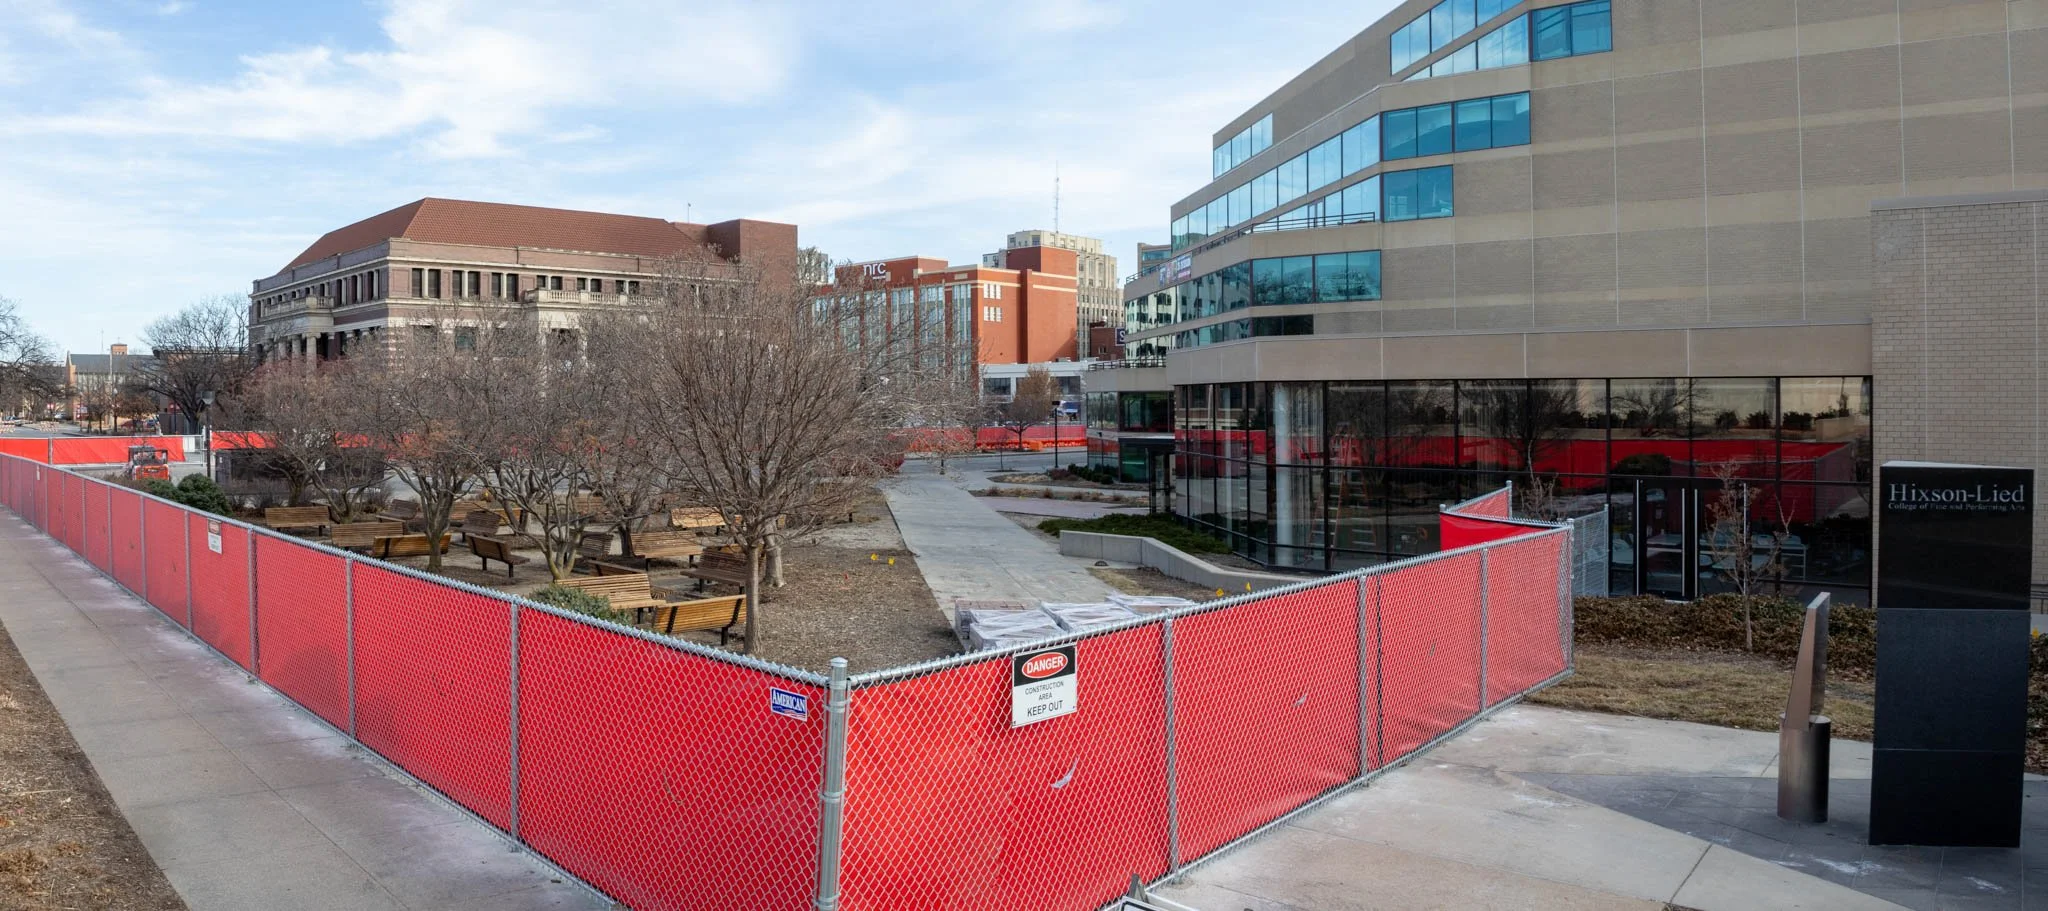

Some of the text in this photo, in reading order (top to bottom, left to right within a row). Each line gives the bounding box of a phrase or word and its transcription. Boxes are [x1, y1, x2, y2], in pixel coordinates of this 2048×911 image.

[863, 262, 886, 276] nrc
[1889, 483, 2024, 502] Hixson-Lied
[1888, 503, 1917, 511] College
[1026, 656, 1064, 674] DANGER
[1025, 681, 1064, 695] CONSTRUCTION
[772, 689, 806, 713] AMERICAN
[1038, 692, 1053, 701] AREA
[1027, 700, 1063, 717] KEEP OUT
